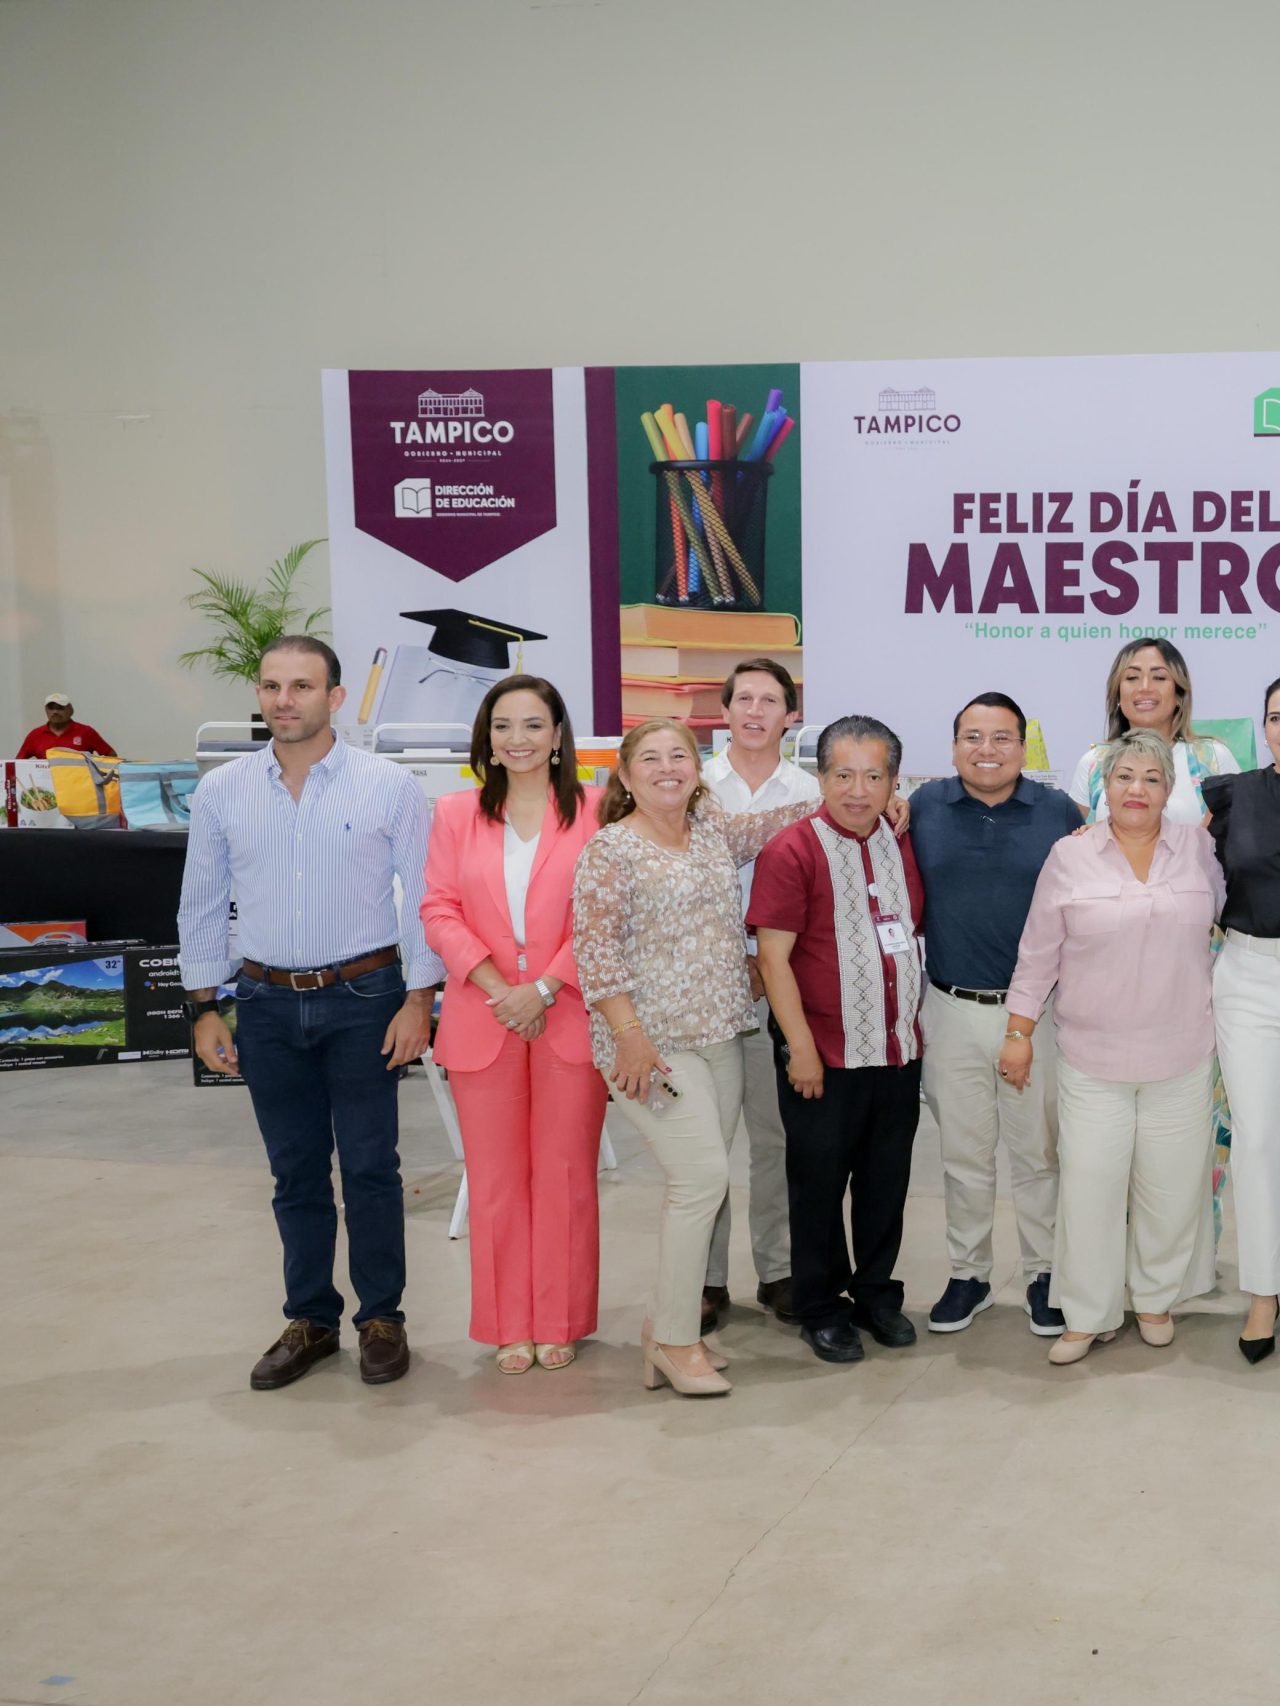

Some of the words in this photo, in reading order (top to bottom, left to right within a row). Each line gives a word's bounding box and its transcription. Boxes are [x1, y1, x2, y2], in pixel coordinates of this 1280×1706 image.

[390, 420, 515, 444] TAMPICO
[854, 414, 961, 434] TAMPICO
[434, 483, 494, 496] DIRECCIÓN
[435, 498, 453, 508] DE
[452, 494, 516, 508] EDUCACIÓN
[953, 491, 1074, 534] FELIZ
[1089, 479, 1178, 533] DÍA
[1040, 626, 1051, 639] a
[1057, 622, 1112, 643] quien
[1119, 623, 1177, 639] honor
